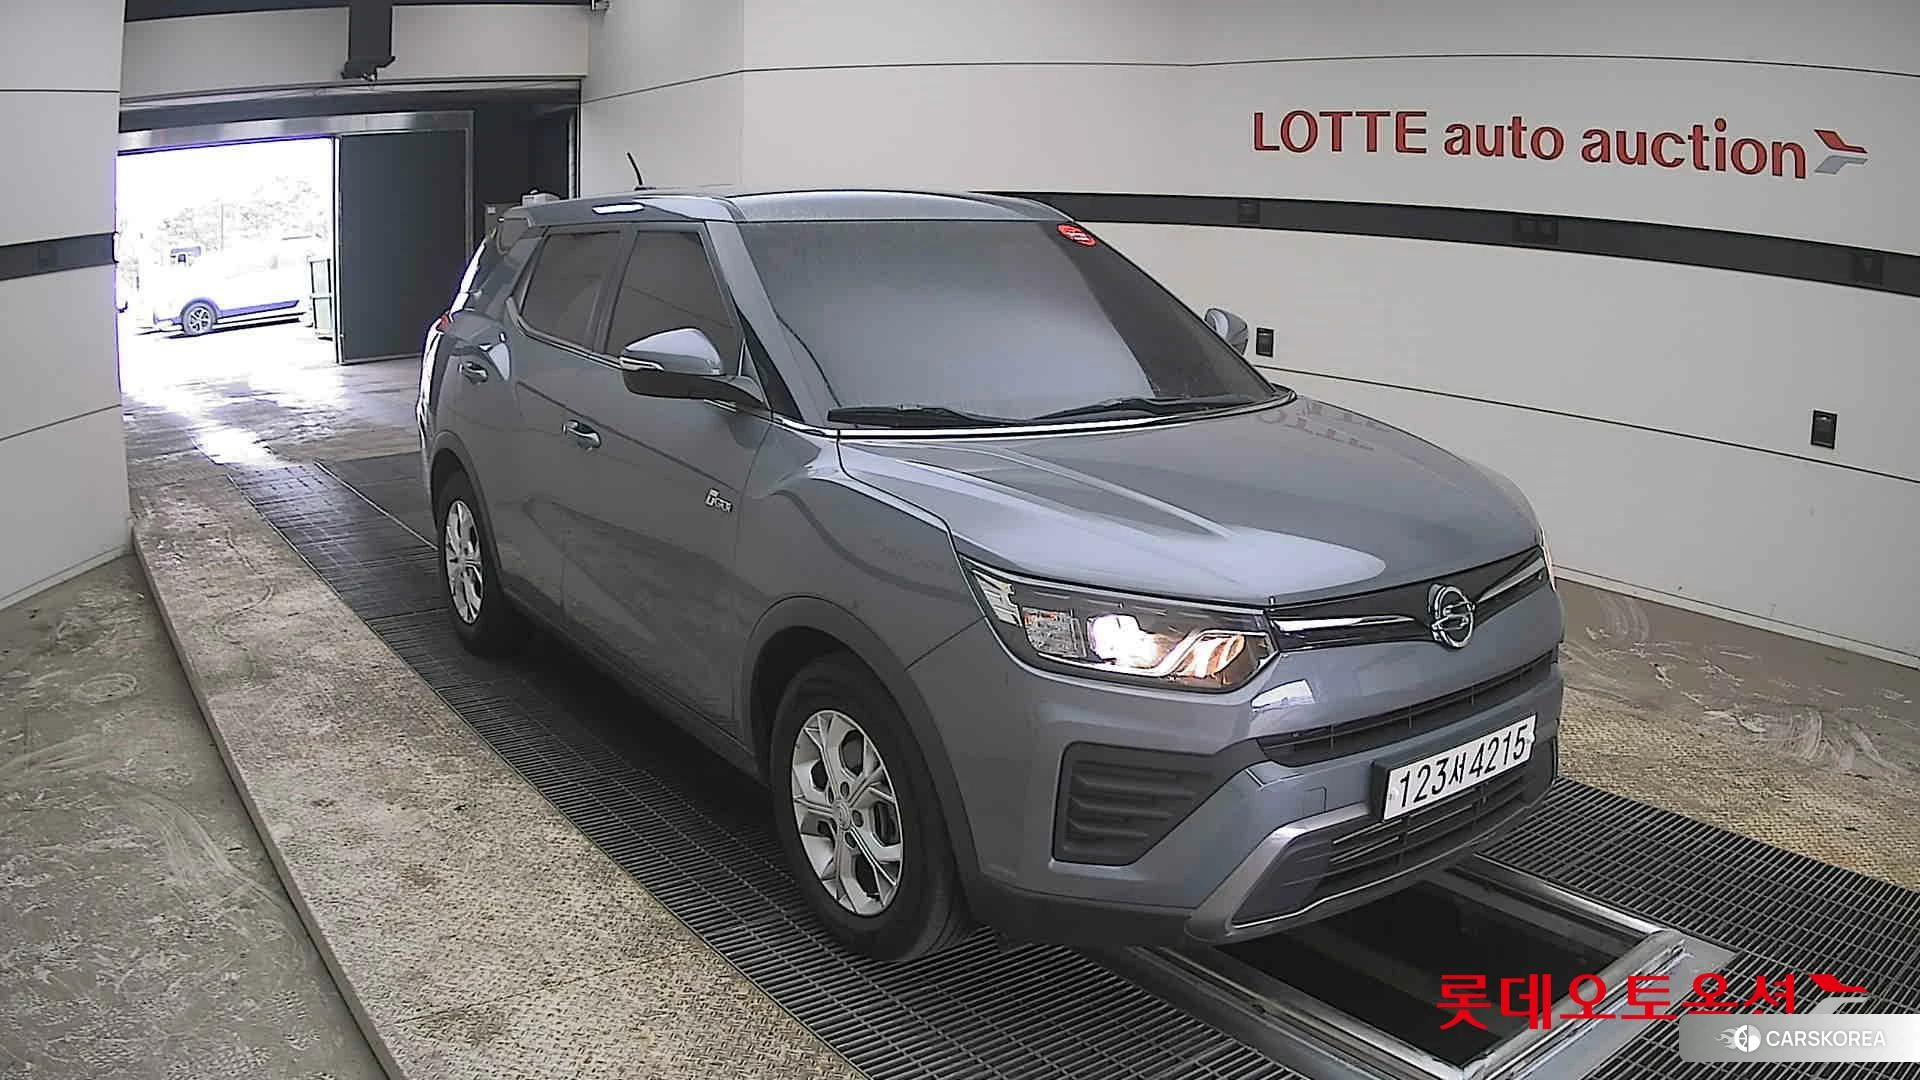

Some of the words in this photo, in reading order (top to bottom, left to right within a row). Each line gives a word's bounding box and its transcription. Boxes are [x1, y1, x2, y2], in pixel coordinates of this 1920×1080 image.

[1254, 111, 1427, 153] LOTTE
[1444, 115, 1564, 160] auto
[1581, 117, 1807, 179] auction
[1400, 725, 1528, 808] 123서4215
